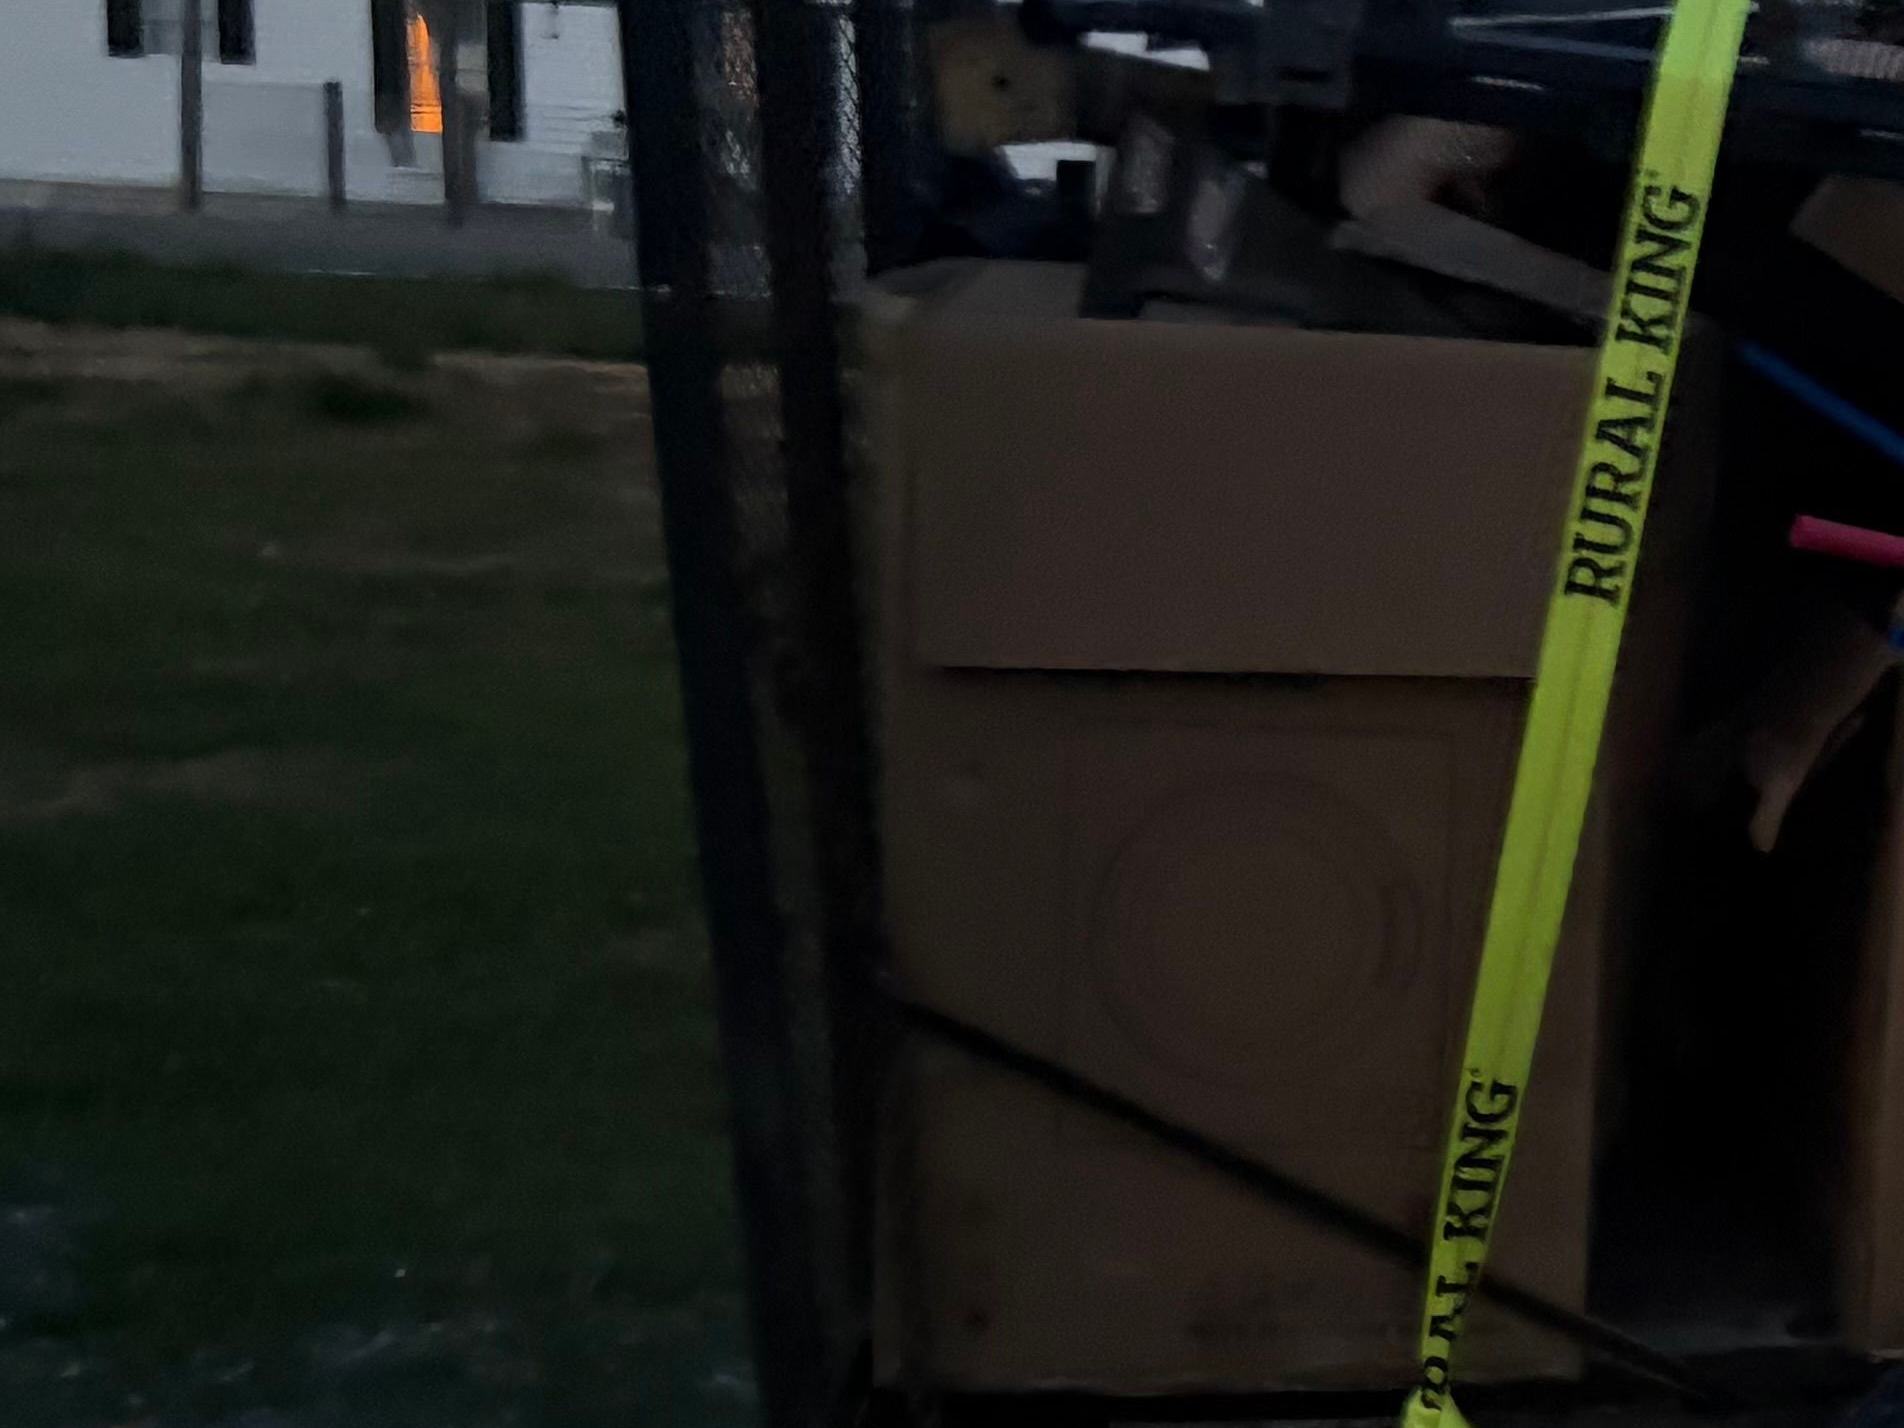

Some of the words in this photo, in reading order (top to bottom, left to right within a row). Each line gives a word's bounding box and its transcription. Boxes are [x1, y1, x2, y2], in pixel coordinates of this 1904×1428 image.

[1613, 183, 1702, 356] KING
[1565, 366, 1667, 609] RURAL
[1442, 1077, 1520, 1243] KING
